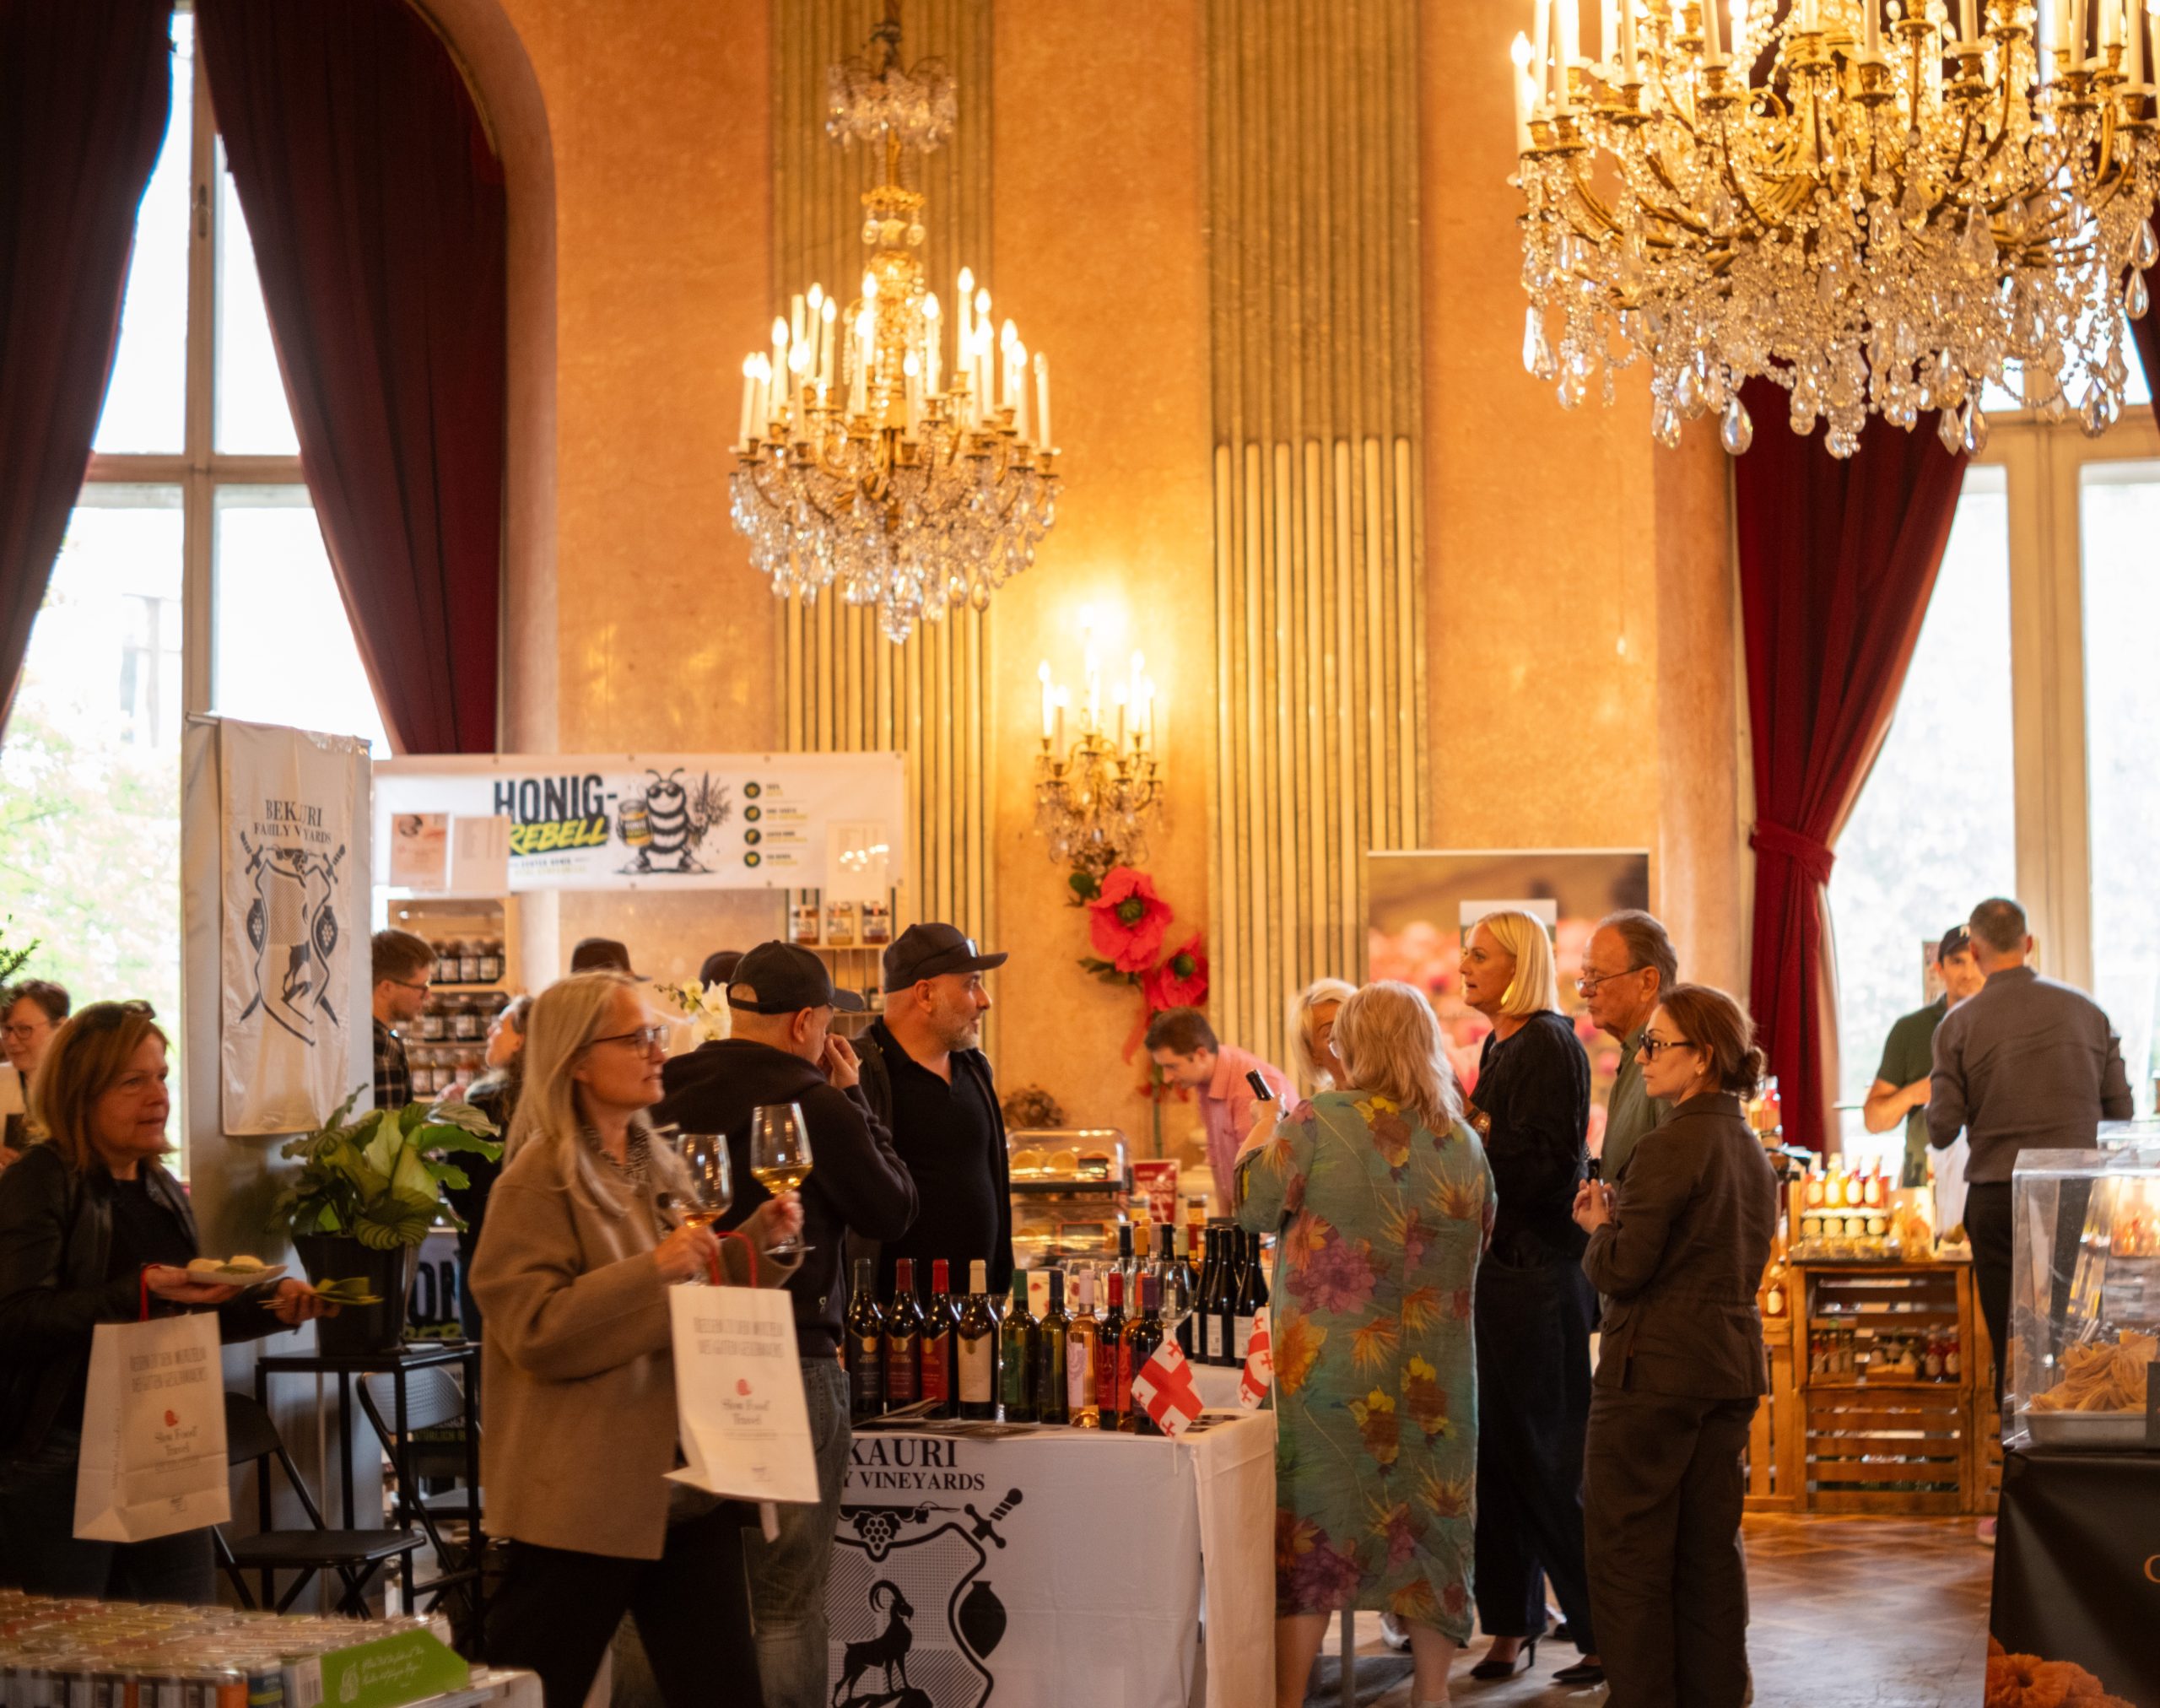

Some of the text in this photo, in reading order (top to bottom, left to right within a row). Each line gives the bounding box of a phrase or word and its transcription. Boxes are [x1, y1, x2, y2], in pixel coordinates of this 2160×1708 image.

[265, 799, 322, 827] BEKURI
[494, 774, 618, 823] HONIG-
[510, 817, 608, 855] REBELL
[860, 1472, 986, 1491] VINEYARDS
